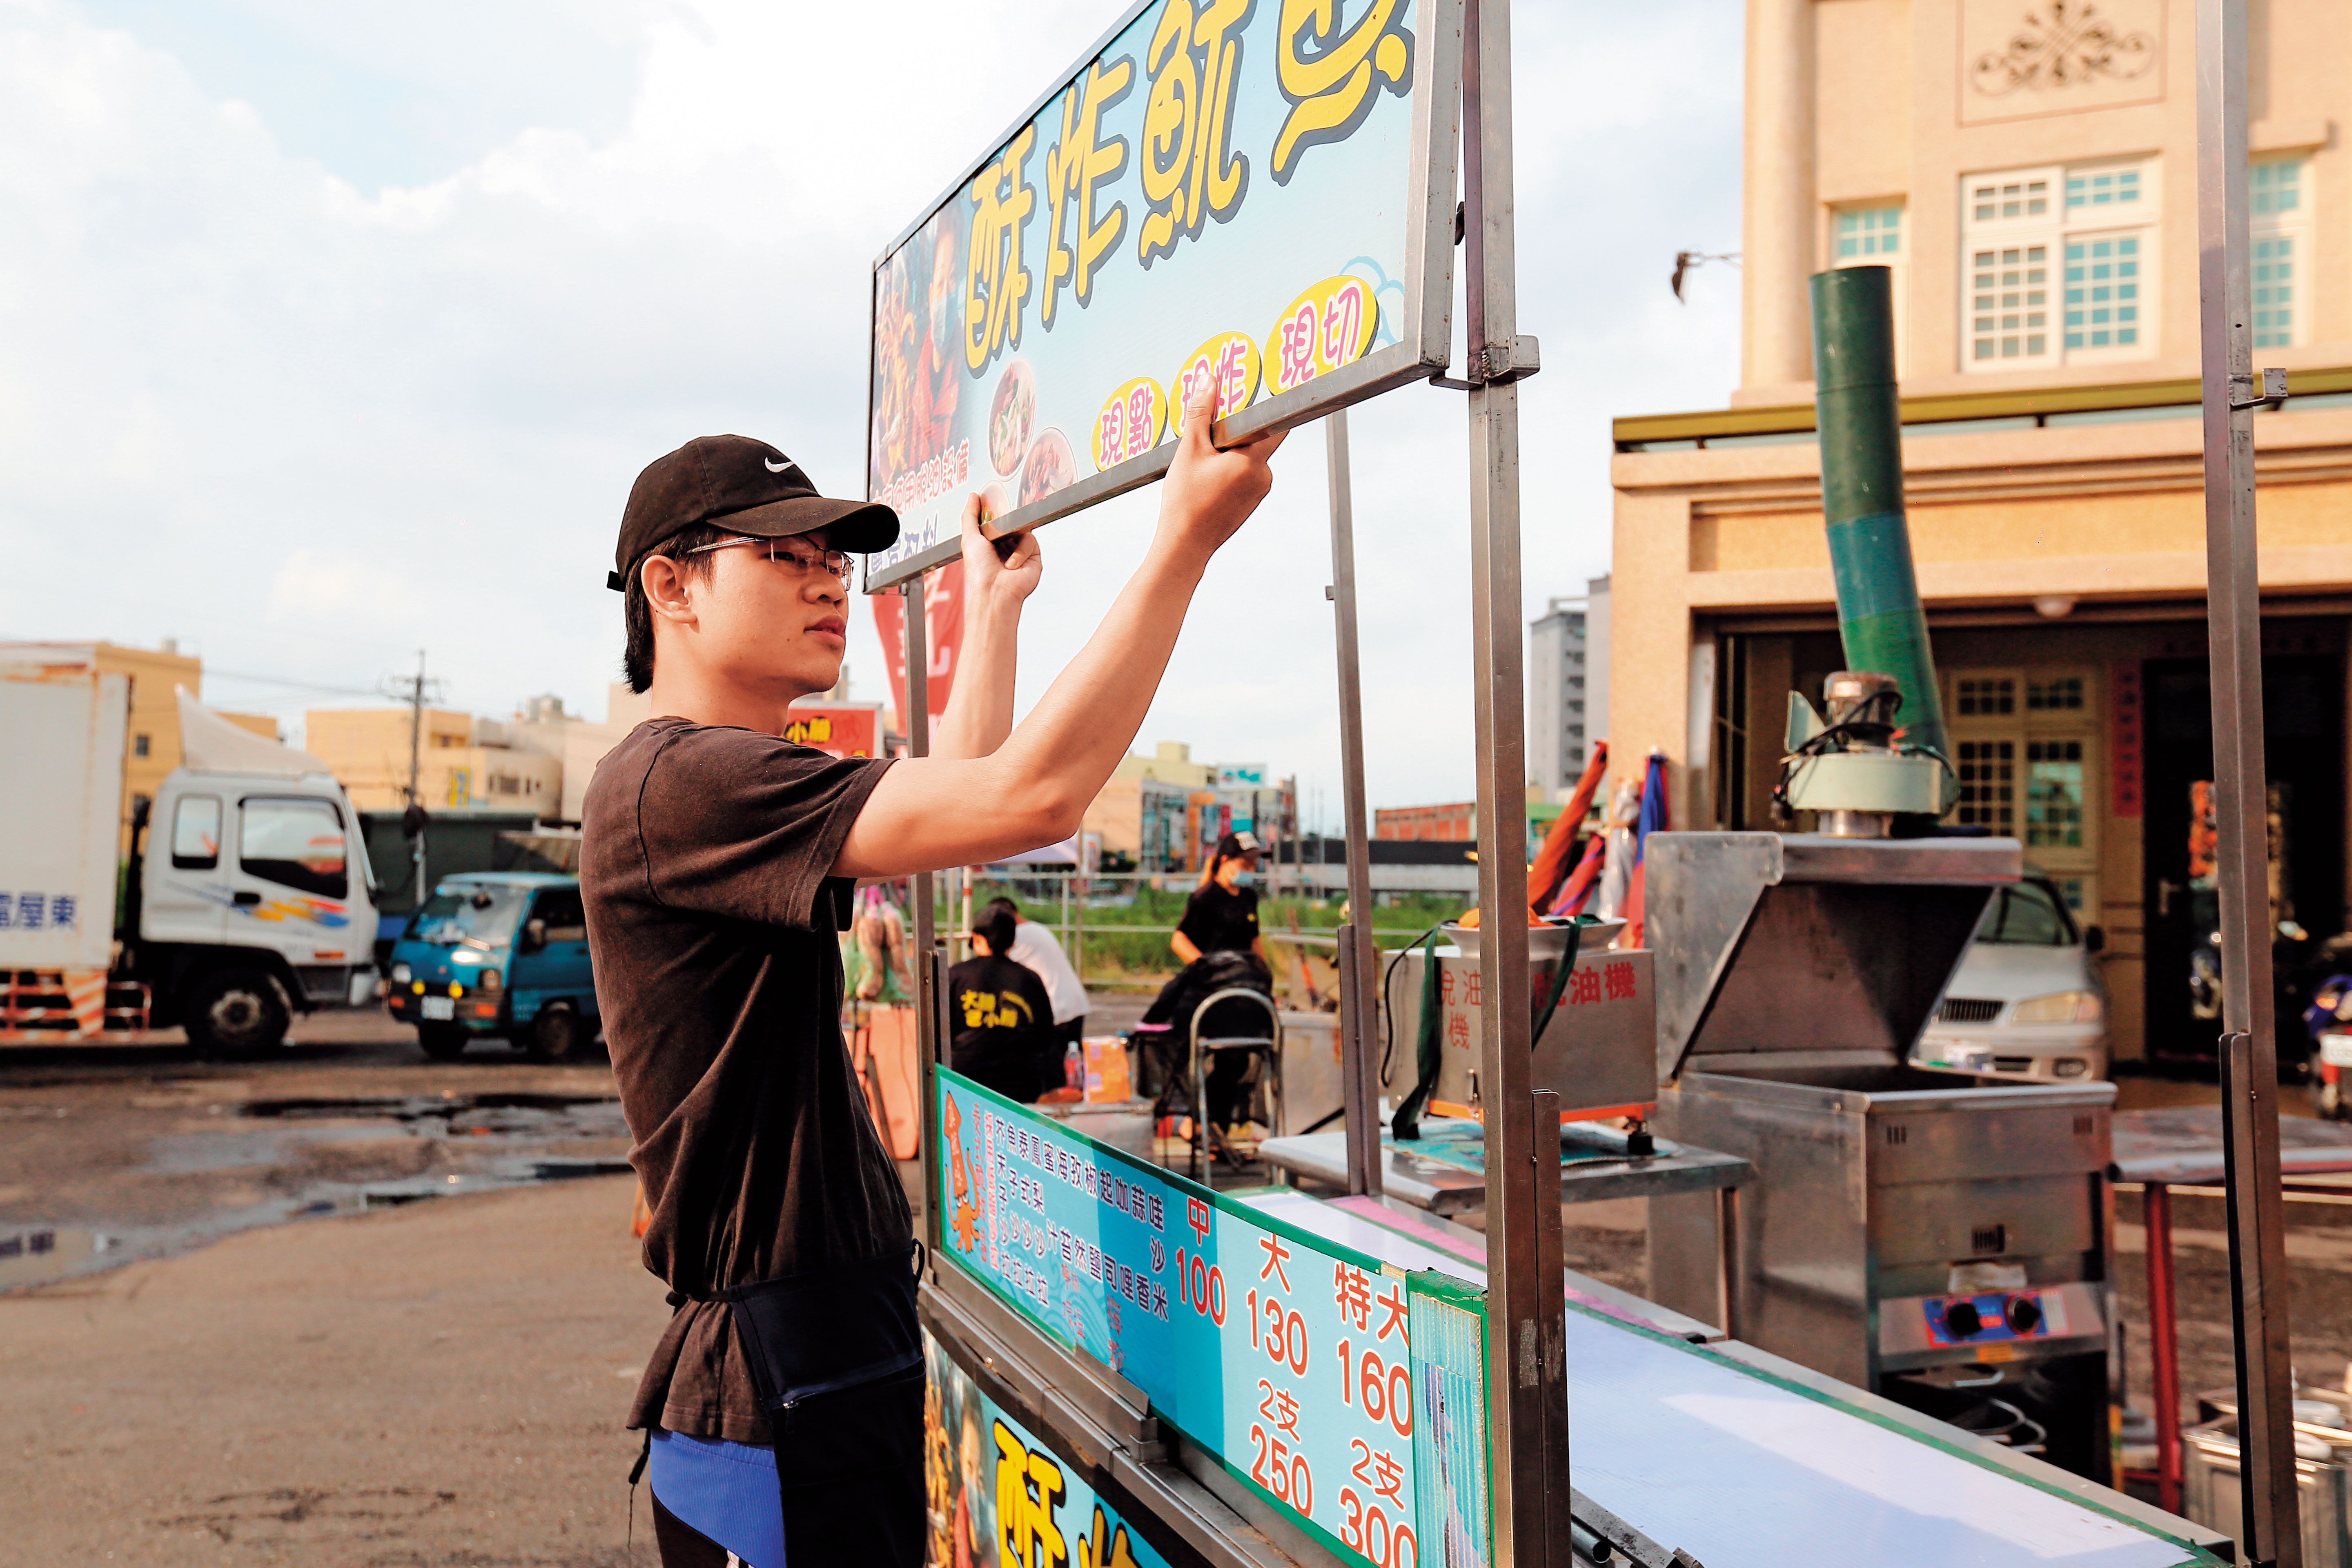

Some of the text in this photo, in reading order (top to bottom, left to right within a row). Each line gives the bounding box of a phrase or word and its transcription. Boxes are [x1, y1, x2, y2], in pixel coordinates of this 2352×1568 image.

[1281, 286, 1360, 387] 現切
[1100, 385, 1153, 466] 現點
[1018, 1130, 1036, 1297] 泰式沙拉
[1043, 1141, 1058, 1253] 蜜汁
[1056, 1147, 1073, 1262] 海苔
[1070, 1153, 1087, 1273] 孜然
[1084, 1160, 1103, 1282] 椒鹽
[1100, 1168, 1118, 1292] 起司
[1115, 1176, 1135, 1302] 咖哩
[1187, 1197, 1209, 1244] 中
[1131, 1184, 1150, 1313] 蒜香
[1148, 1192, 1169, 1322] 哇沙米
[1176, 1247, 1225, 1327] 100
[1260, 1233, 1290, 1293] 大
[1247, 1287, 1308, 1376] 130
[1334, 1261, 1410, 1352] 特大
[1258, 1379, 1300, 1442] 2支
[1338, 1339, 1413, 1437] 160
[1250, 1425, 1312, 1519] 250
[1351, 1439, 1404, 1510] 2支
[1340, 1488, 1418, 1568] 300
